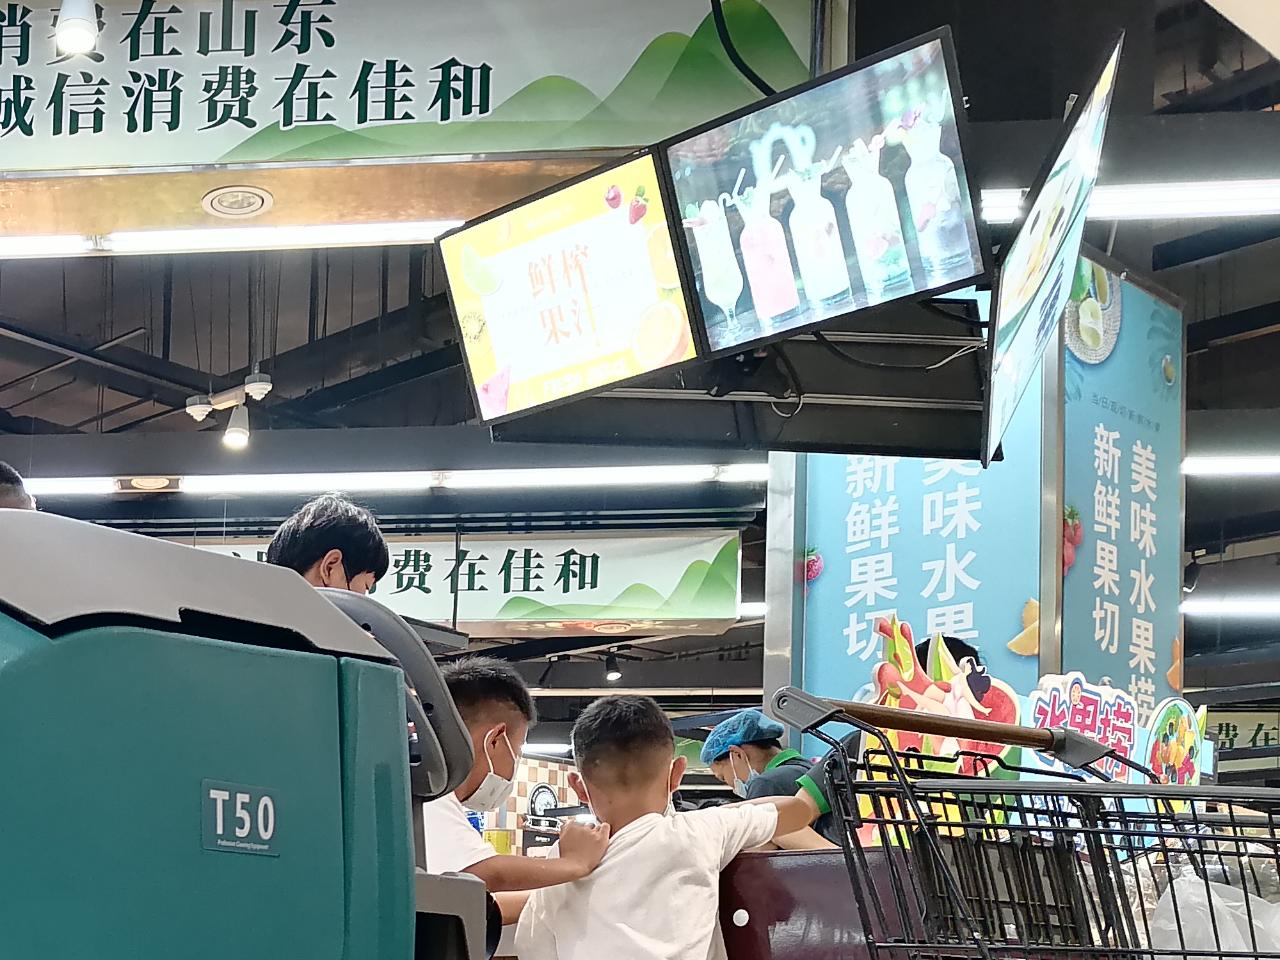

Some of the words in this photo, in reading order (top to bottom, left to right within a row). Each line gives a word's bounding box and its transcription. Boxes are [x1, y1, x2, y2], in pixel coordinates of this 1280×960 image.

[843, 455, 900, 662] 新鲜果切
[1092, 423, 1121, 655] 新鲜果切
[210, 789, 275, 840] T50
